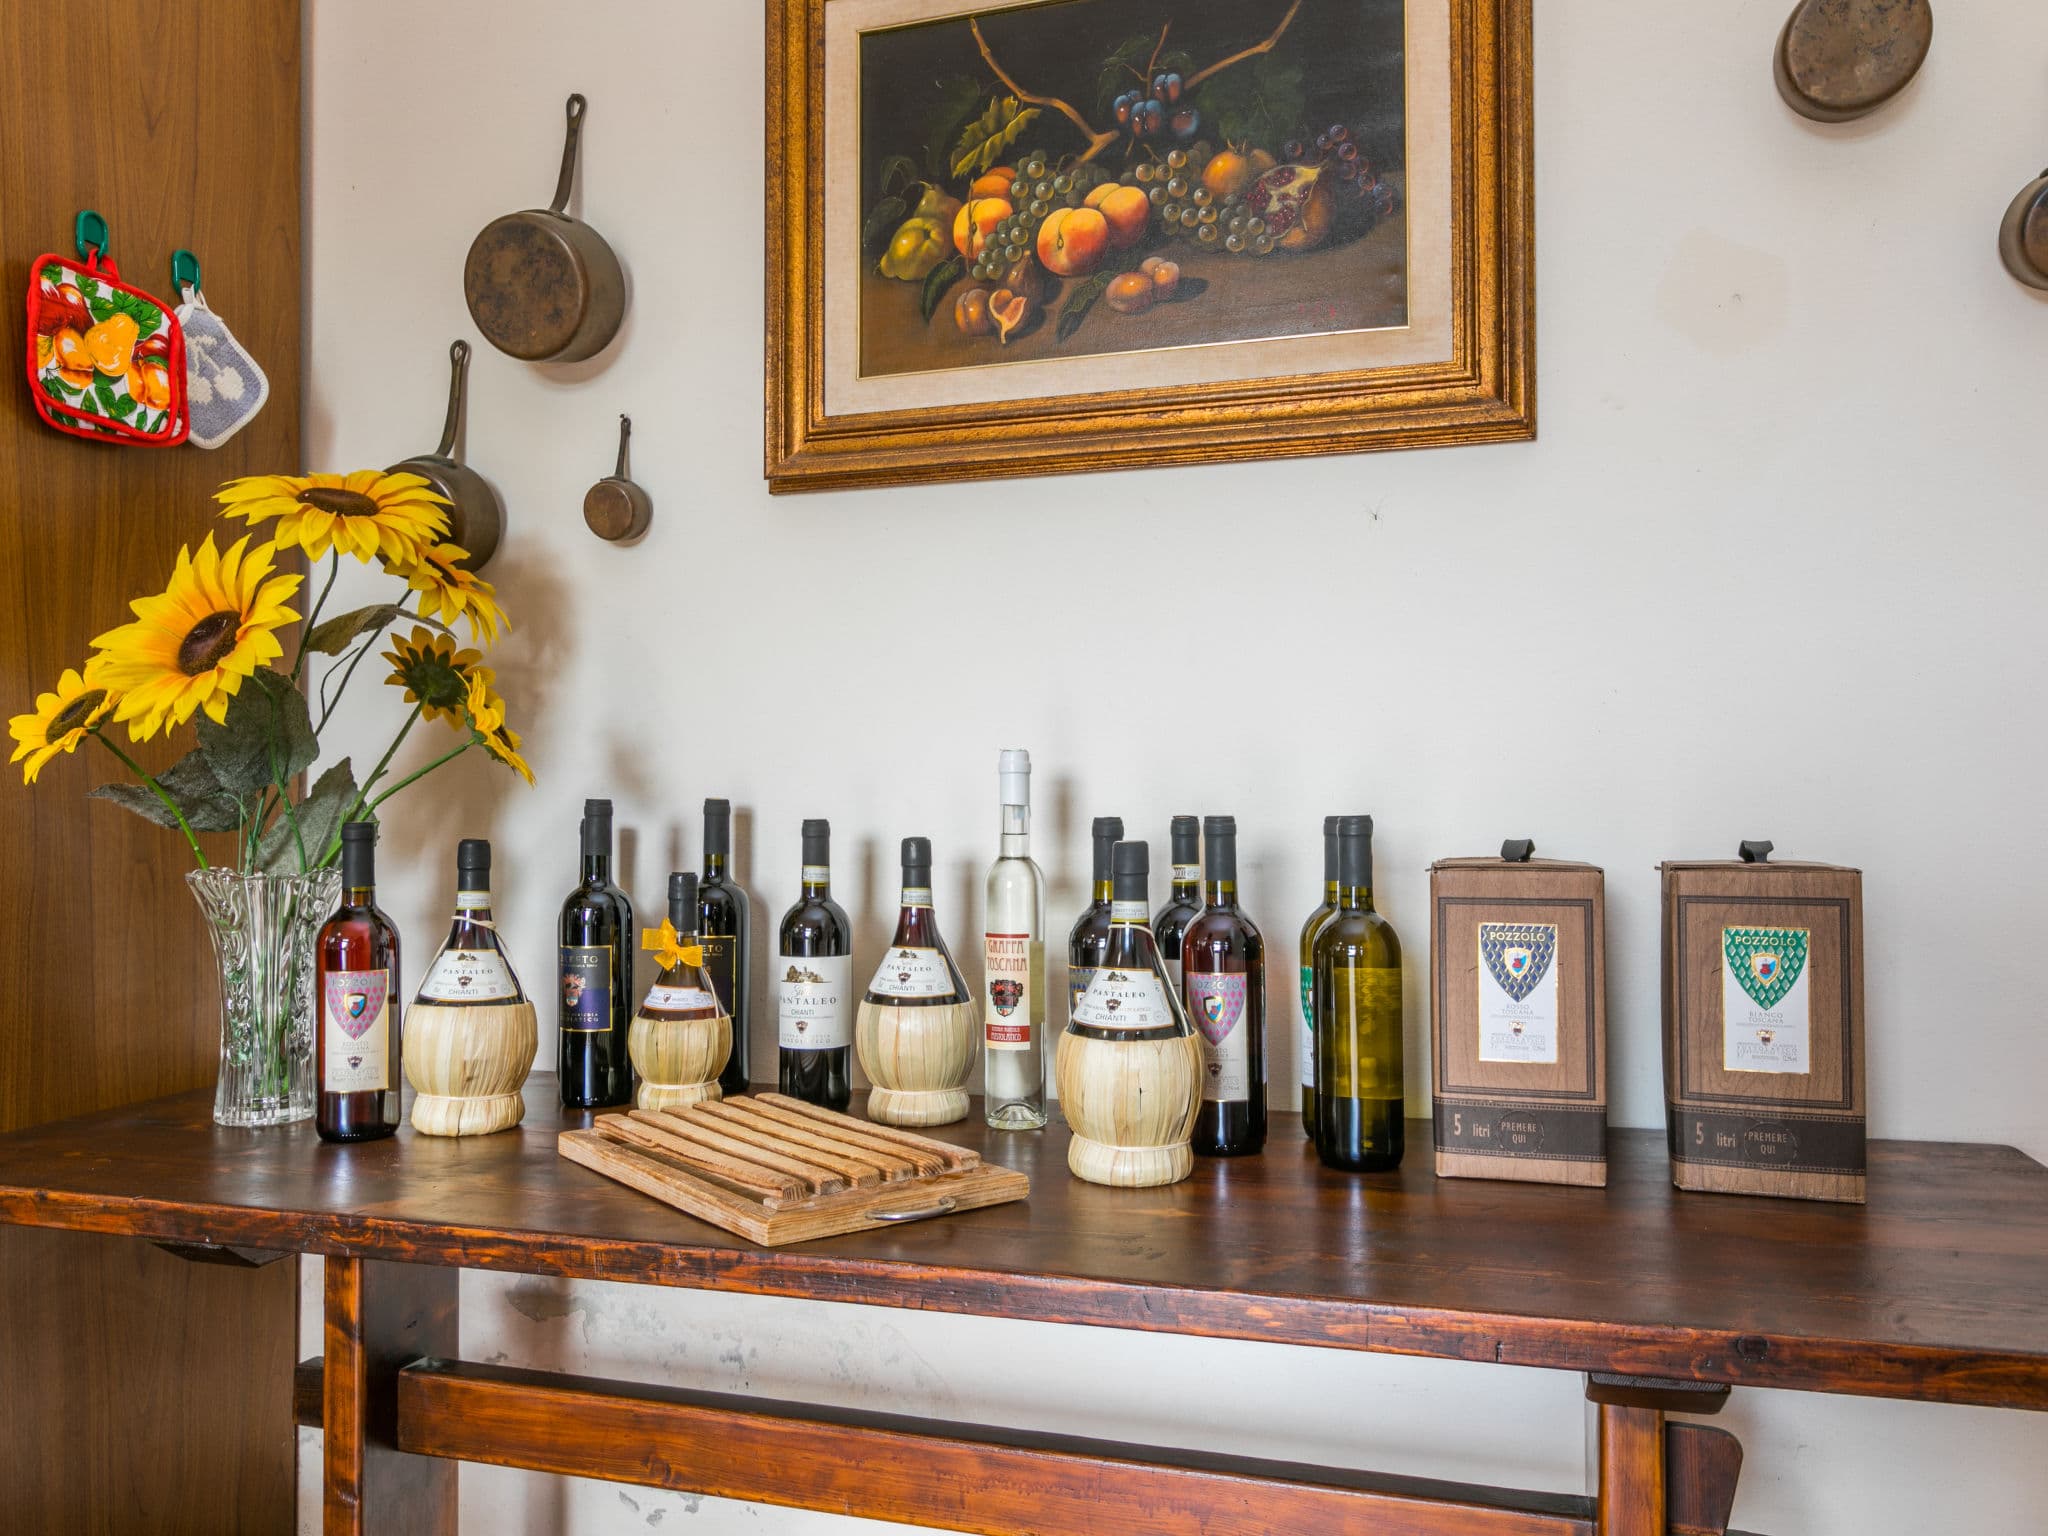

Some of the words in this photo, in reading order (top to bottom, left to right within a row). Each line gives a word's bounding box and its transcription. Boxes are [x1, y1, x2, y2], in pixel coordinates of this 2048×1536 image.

[1489, 931, 1547, 942] POZZOLO
[1734, 935, 1797, 947] POZZOLO
[987, 939, 1025, 954] GRAPPA
[986, 956, 1028, 971] TOSCANA
[1092, 988, 1146, 998] PANTALEO
[1095, 1012, 1127, 1023] CHIANTI
[1453, 1113, 1462, 1136] 5
[1472, 1123, 1490, 1138] litri
[1501, 1121, 1537, 1133] PREMERE
[1512, 1134, 1527, 1144] QUI
[1695, 1121, 1705, 1145] 5
[1716, 1132, 1737, 1148] litri
[1748, 1131, 1787, 1144] PREMERE
[1760, 1144, 1776, 1155] QUI
